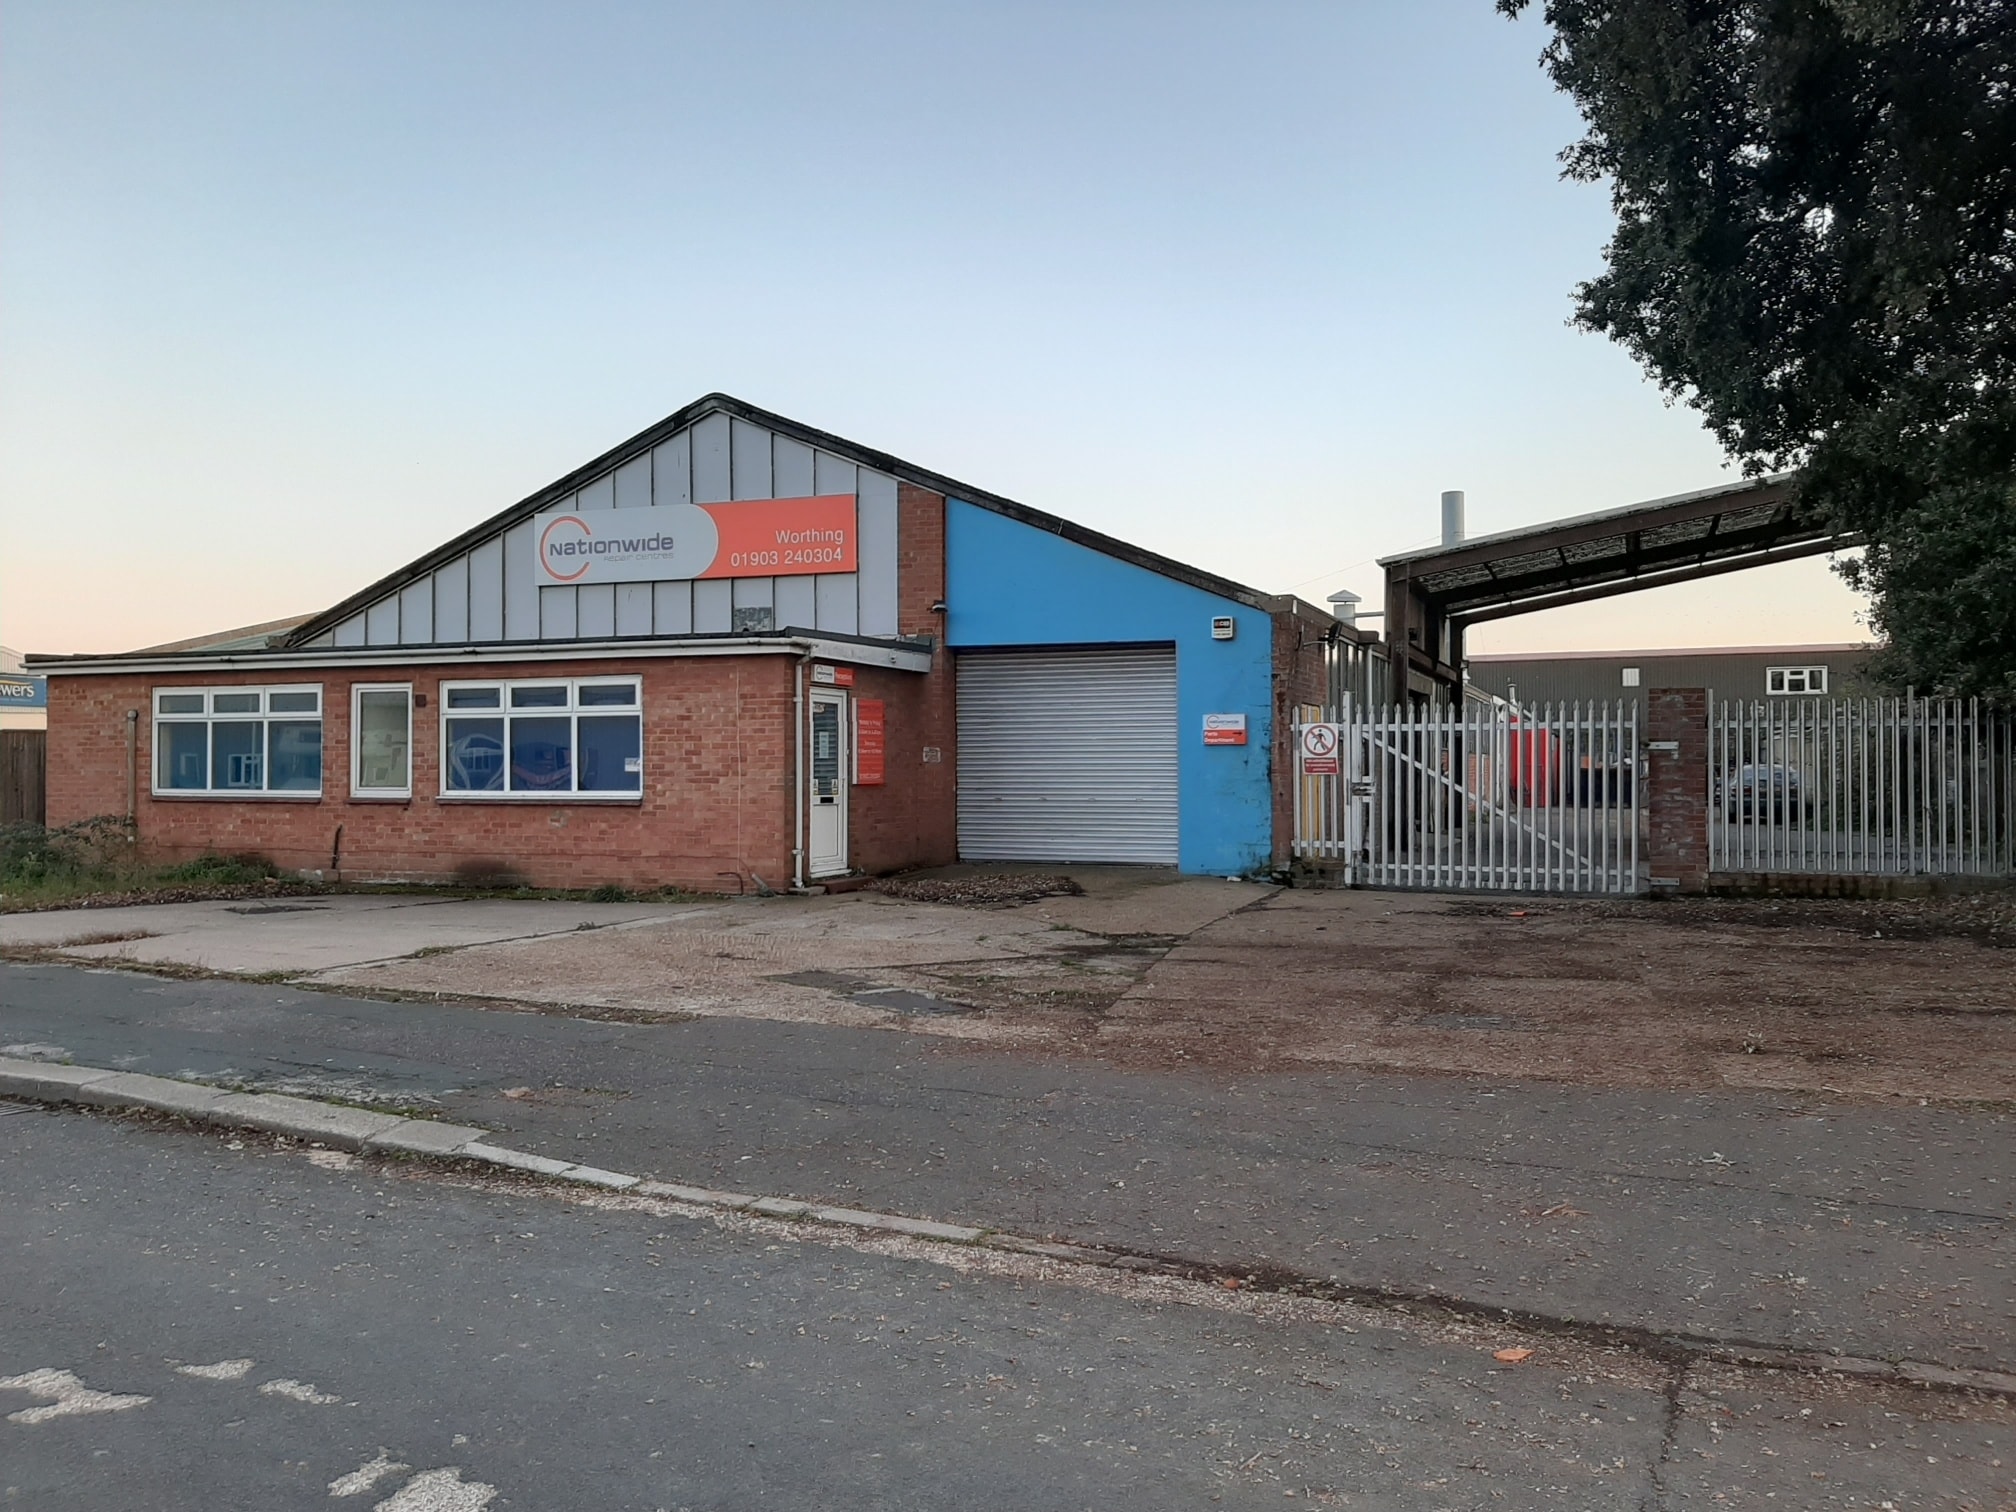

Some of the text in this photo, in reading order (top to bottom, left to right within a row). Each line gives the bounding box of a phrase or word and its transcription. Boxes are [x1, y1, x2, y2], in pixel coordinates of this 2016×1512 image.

[549, 532, 674, 556] Nationwide
[775, 528, 844, 545] Worthing
[604, 551, 674, 564] repair centres
[731, 547, 842, 567] 01903 240304
[0, 684, 35, 698] wers
